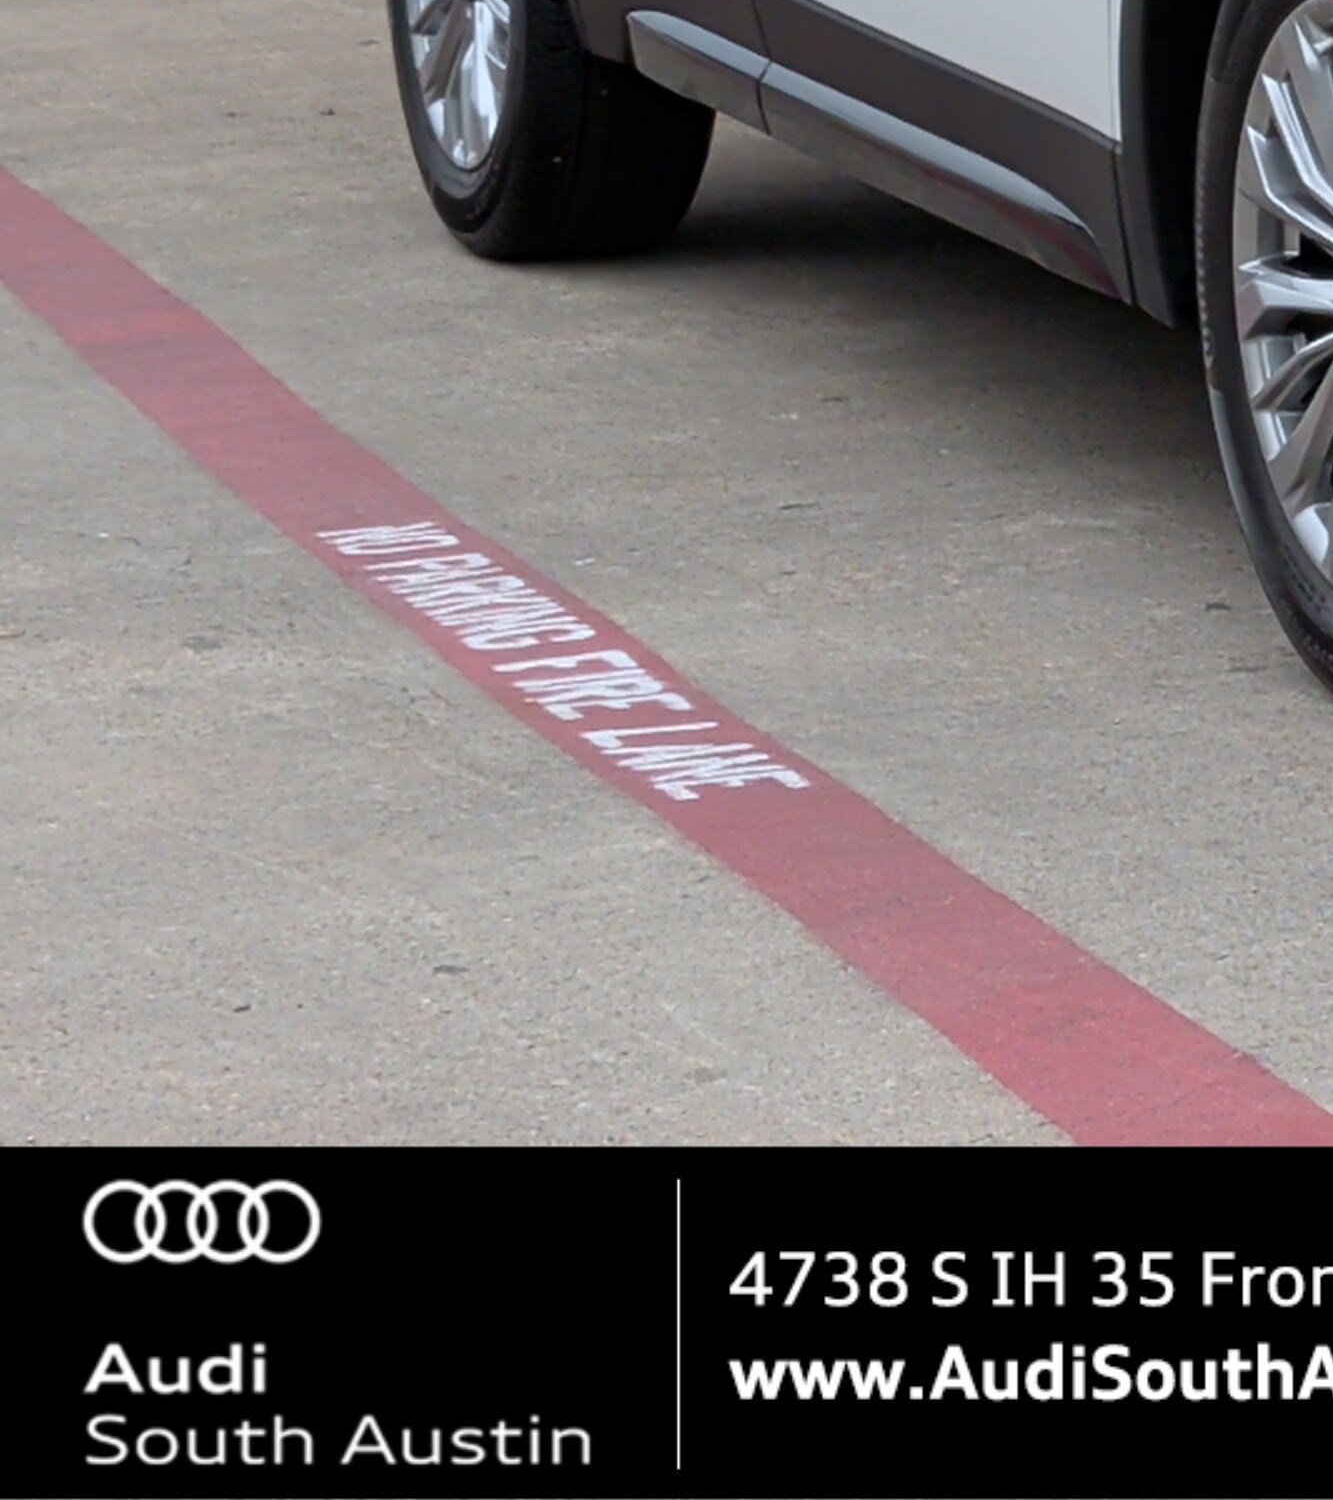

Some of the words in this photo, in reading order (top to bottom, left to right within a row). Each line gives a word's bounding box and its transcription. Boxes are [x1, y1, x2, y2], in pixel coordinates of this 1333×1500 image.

[315, 521, 459, 555] NO
[363, 552, 597, 651] PARKING
[491, 649, 695, 722] FIRE
[578, 721, 811, 801] LANE
